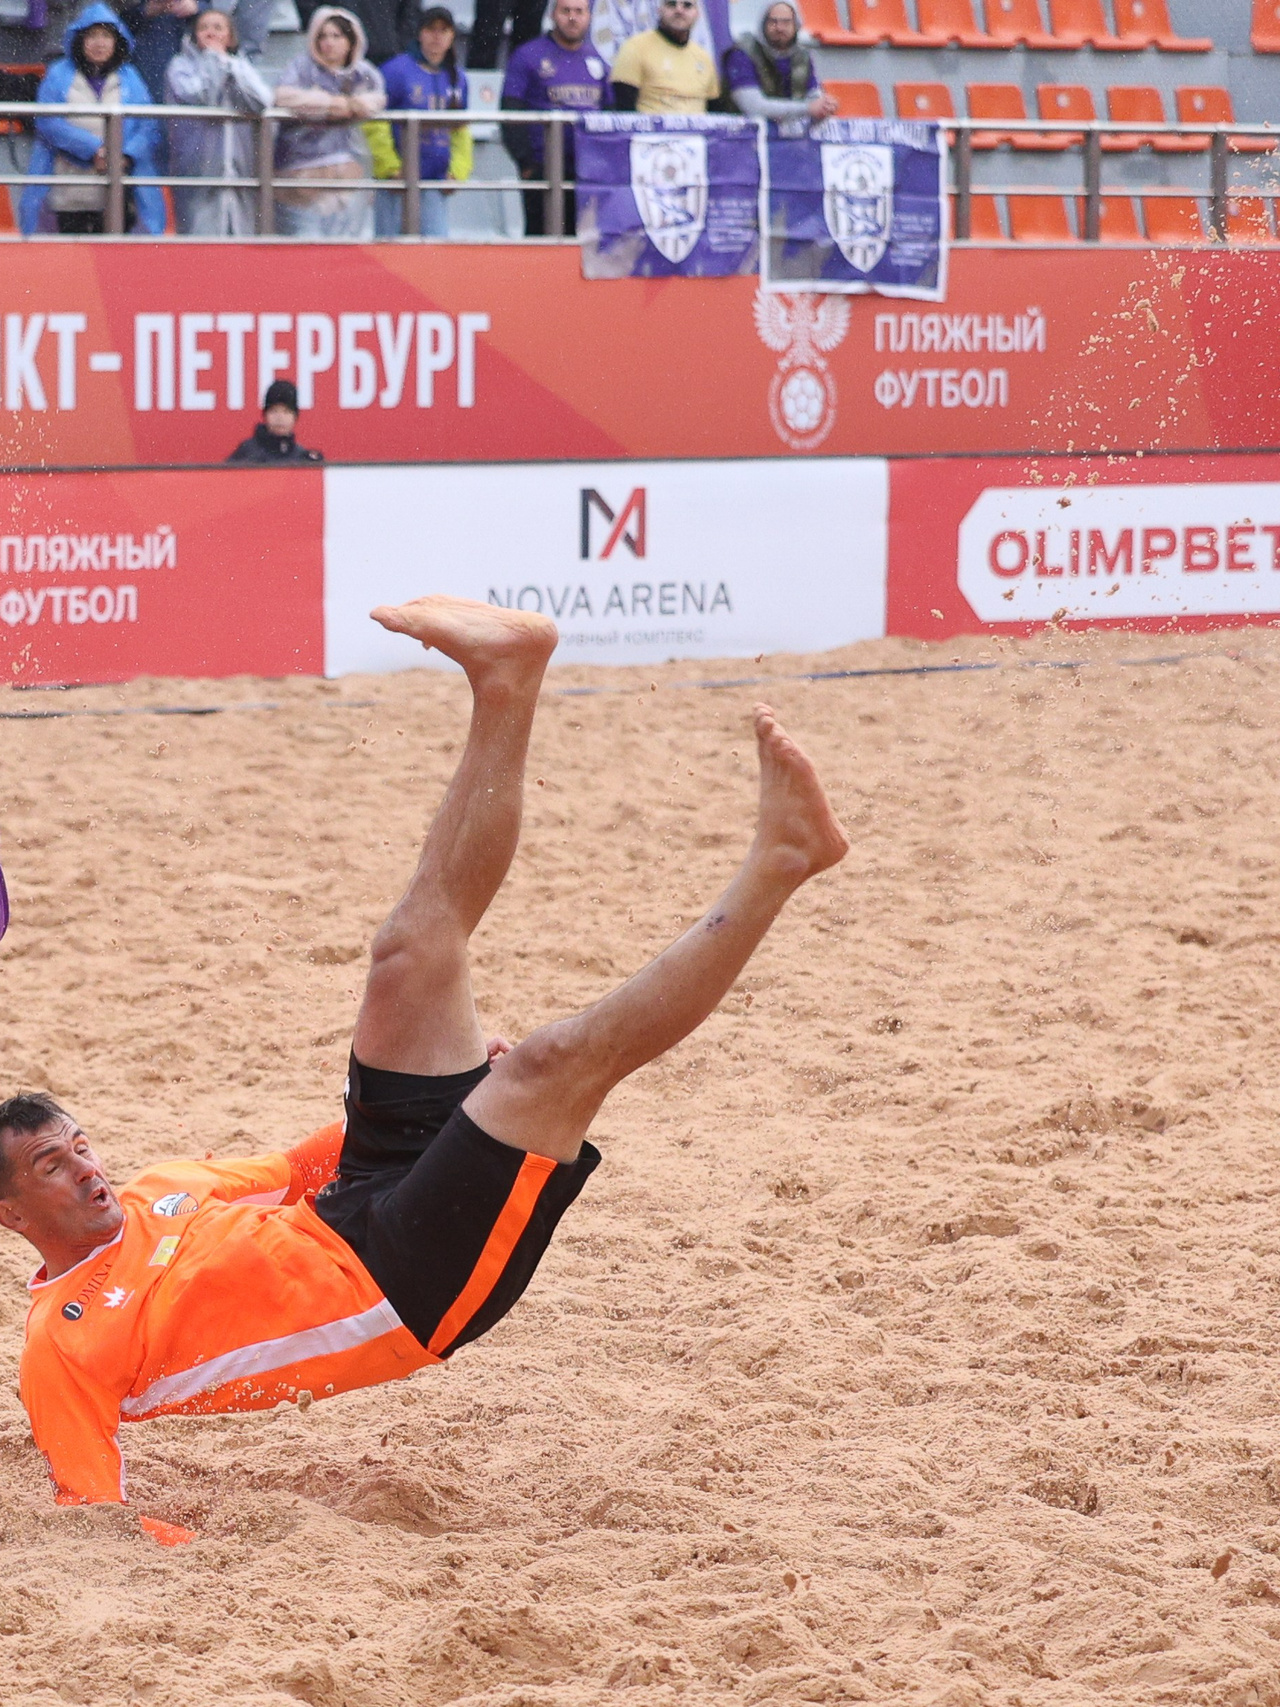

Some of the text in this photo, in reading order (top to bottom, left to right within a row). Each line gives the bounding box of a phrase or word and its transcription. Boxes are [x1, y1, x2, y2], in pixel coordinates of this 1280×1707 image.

[873, 306, 1047, 352] ПЛЯЖНЫЙ
[873, 368, 1009, 408] ФУТБОЛ
[603, 581, 733, 616] ARENA
